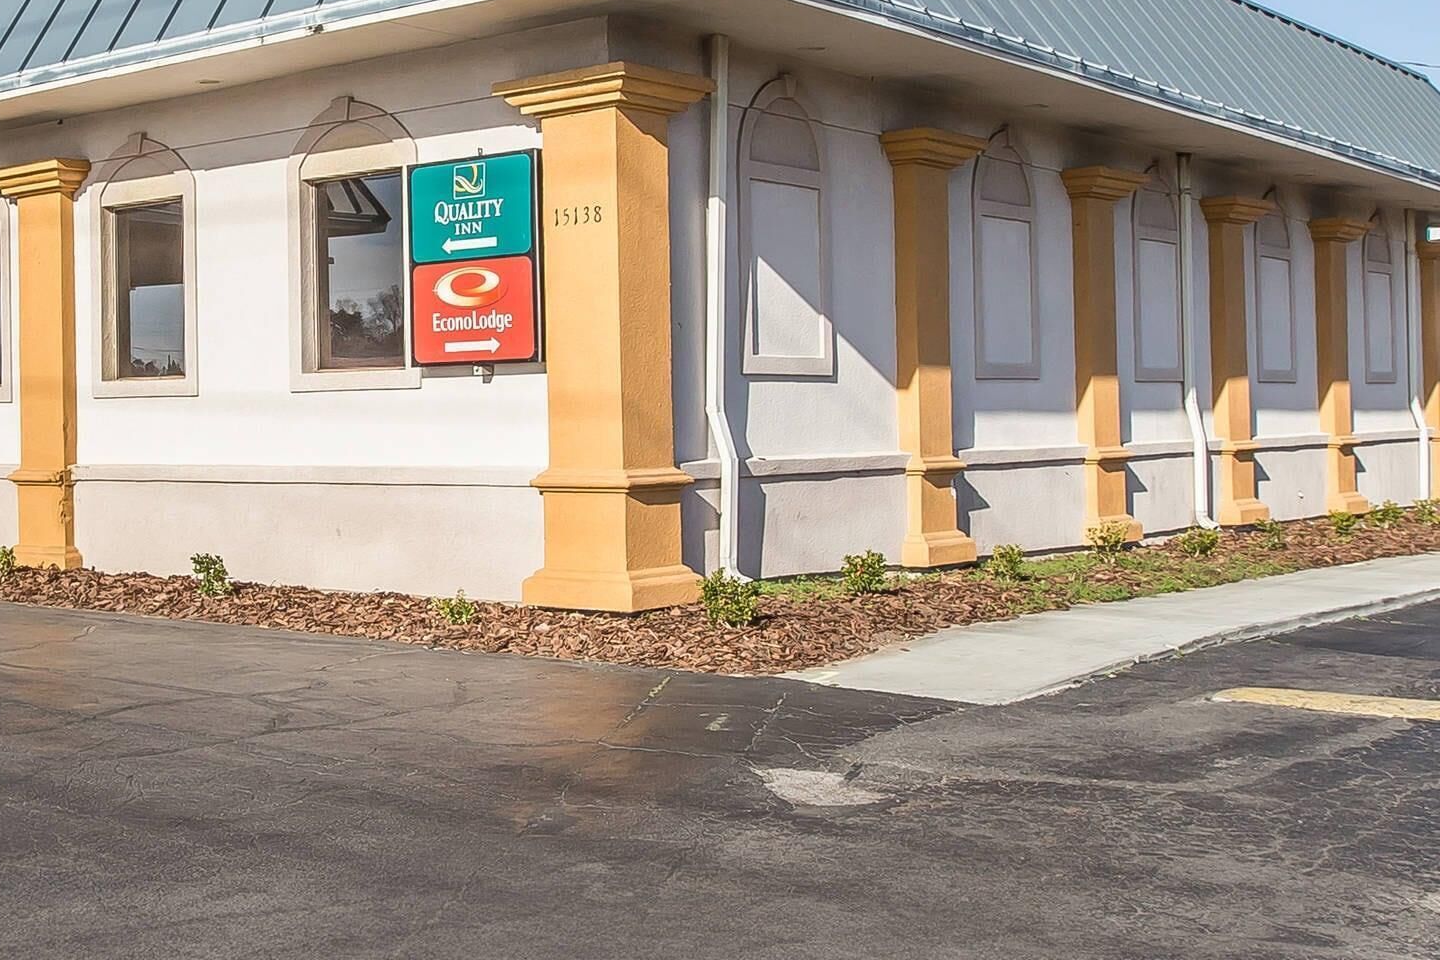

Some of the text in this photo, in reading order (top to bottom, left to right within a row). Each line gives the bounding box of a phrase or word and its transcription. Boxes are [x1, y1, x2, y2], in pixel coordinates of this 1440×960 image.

[434, 198, 504, 225] QUALITY
[554, 205, 603, 227] 15138
[454, 221, 483, 236] INN
[432, 309, 514, 333] EconoLodge
